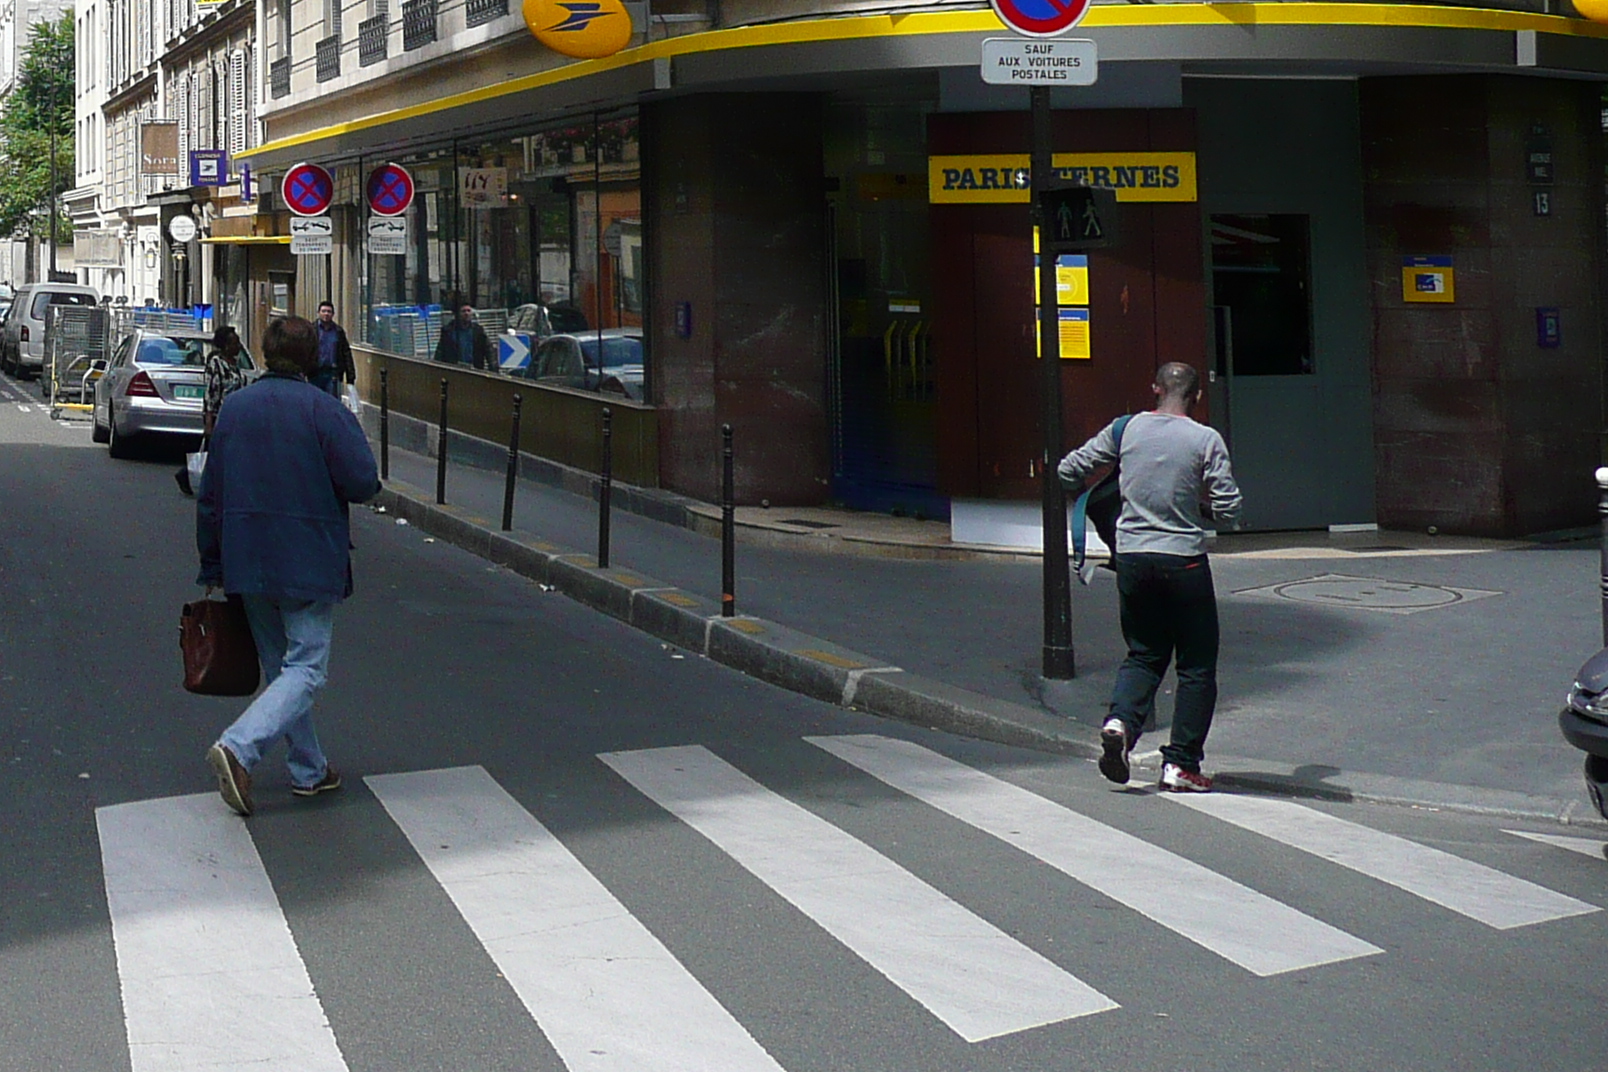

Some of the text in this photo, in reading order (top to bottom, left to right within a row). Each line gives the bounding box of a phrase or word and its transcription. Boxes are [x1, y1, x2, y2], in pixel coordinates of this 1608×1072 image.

[1025, 45, 1054, 54] SAUF
[998, 57, 1082, 67] AUX VOITURES
[1012, 69, 1068, 80] POSTALES
[942, 168, 1031, 190] PARIS
[1536, 193, 1549, 214] 13
